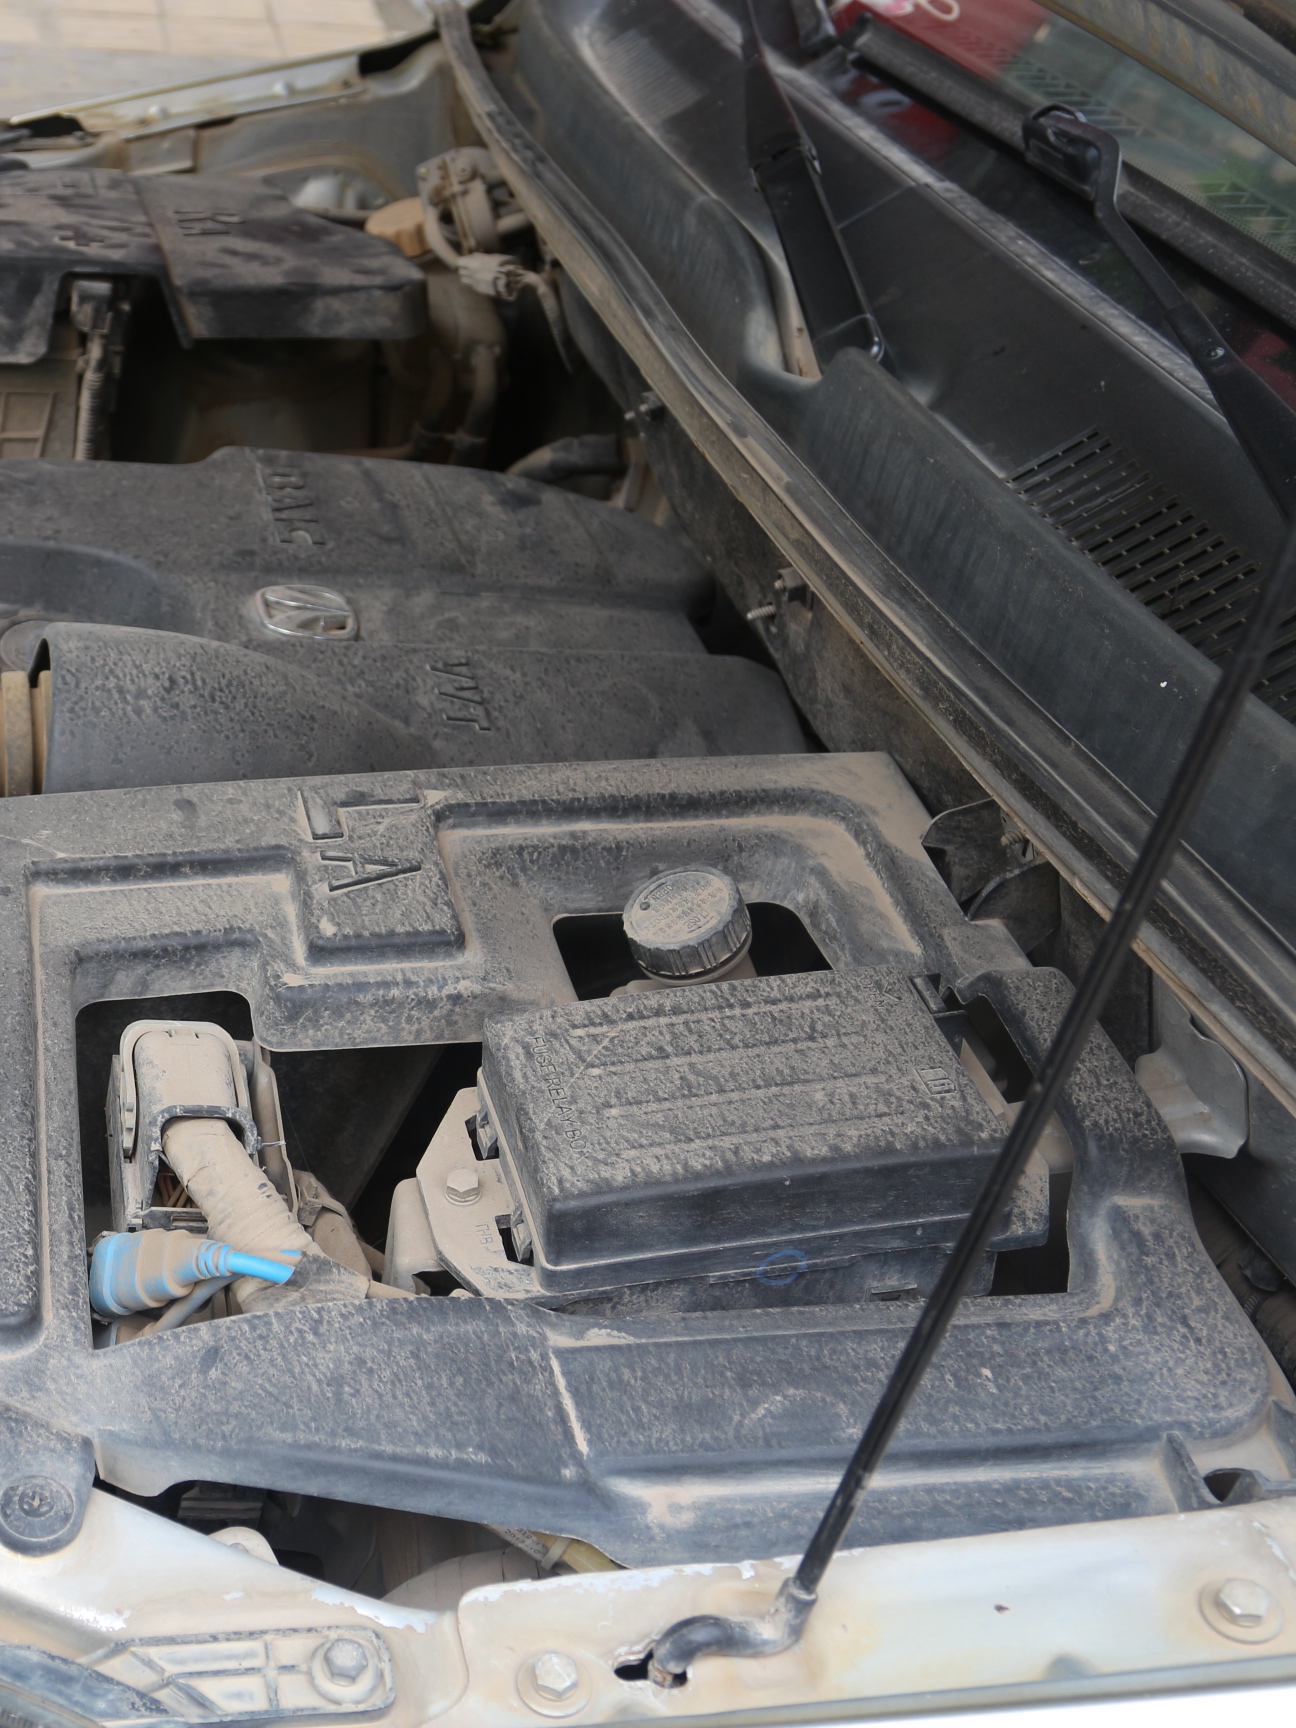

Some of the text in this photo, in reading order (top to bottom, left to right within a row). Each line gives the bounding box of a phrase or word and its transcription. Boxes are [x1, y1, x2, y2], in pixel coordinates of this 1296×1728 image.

[427, 658, 491, 732] VVT
[650, 884, 673, 902] OPEN
[684, 910, 709, 930] CLOSE
[859, 978, 885, 1007] OPEN
[545, 1077, 578, 1123] RELAY
[565, 1128, 589, 1161] BOX
[475, 1224, 493, 1244] THB
